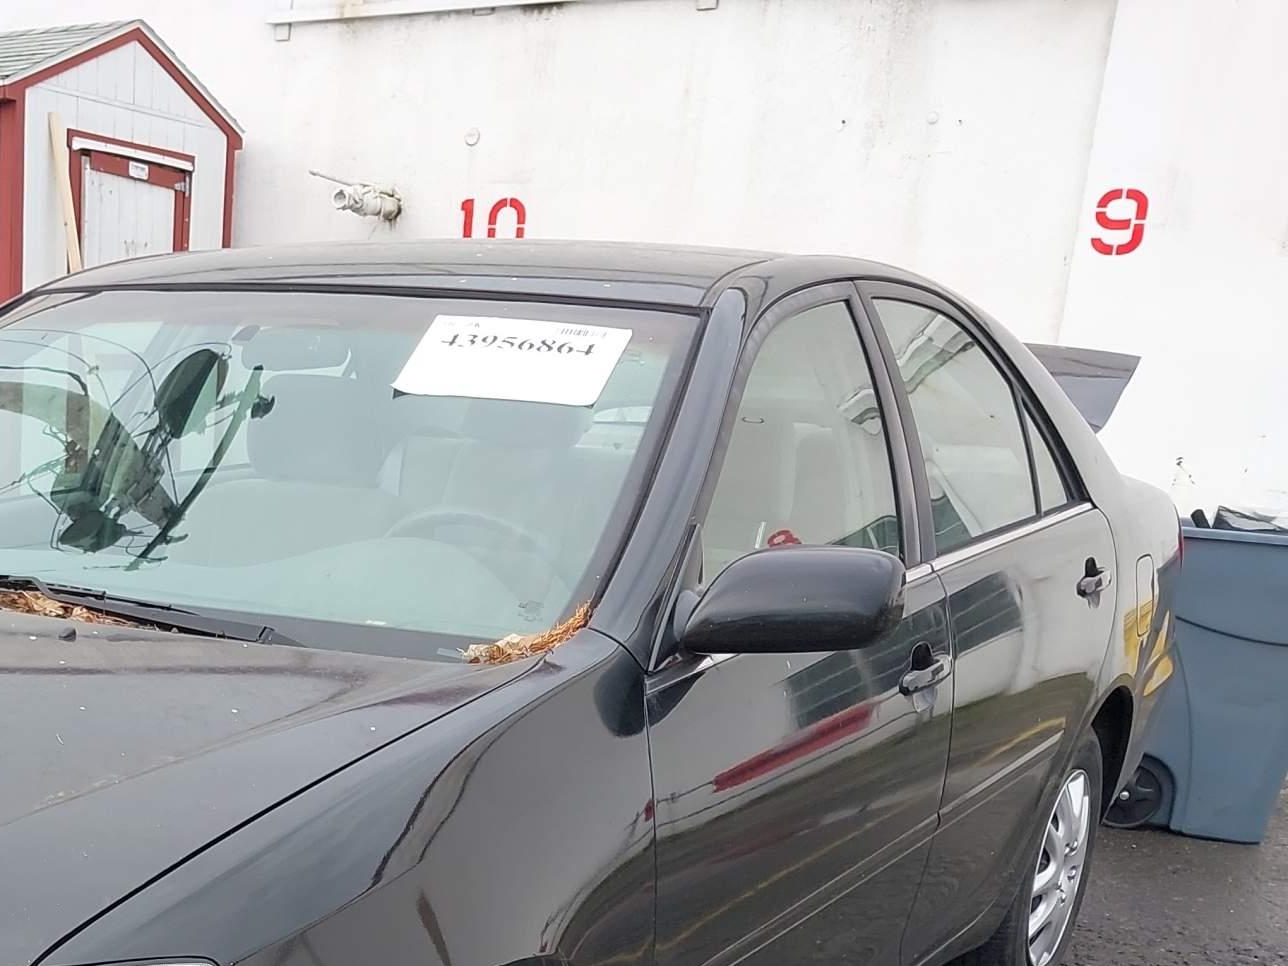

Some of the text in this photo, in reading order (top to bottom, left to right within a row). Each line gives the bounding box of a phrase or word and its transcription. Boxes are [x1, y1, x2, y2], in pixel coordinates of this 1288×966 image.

[461, 197, 526, 238] 10
[1091, 188, 1149, 255] 9
[441, 332, 596, 356] 43956864
